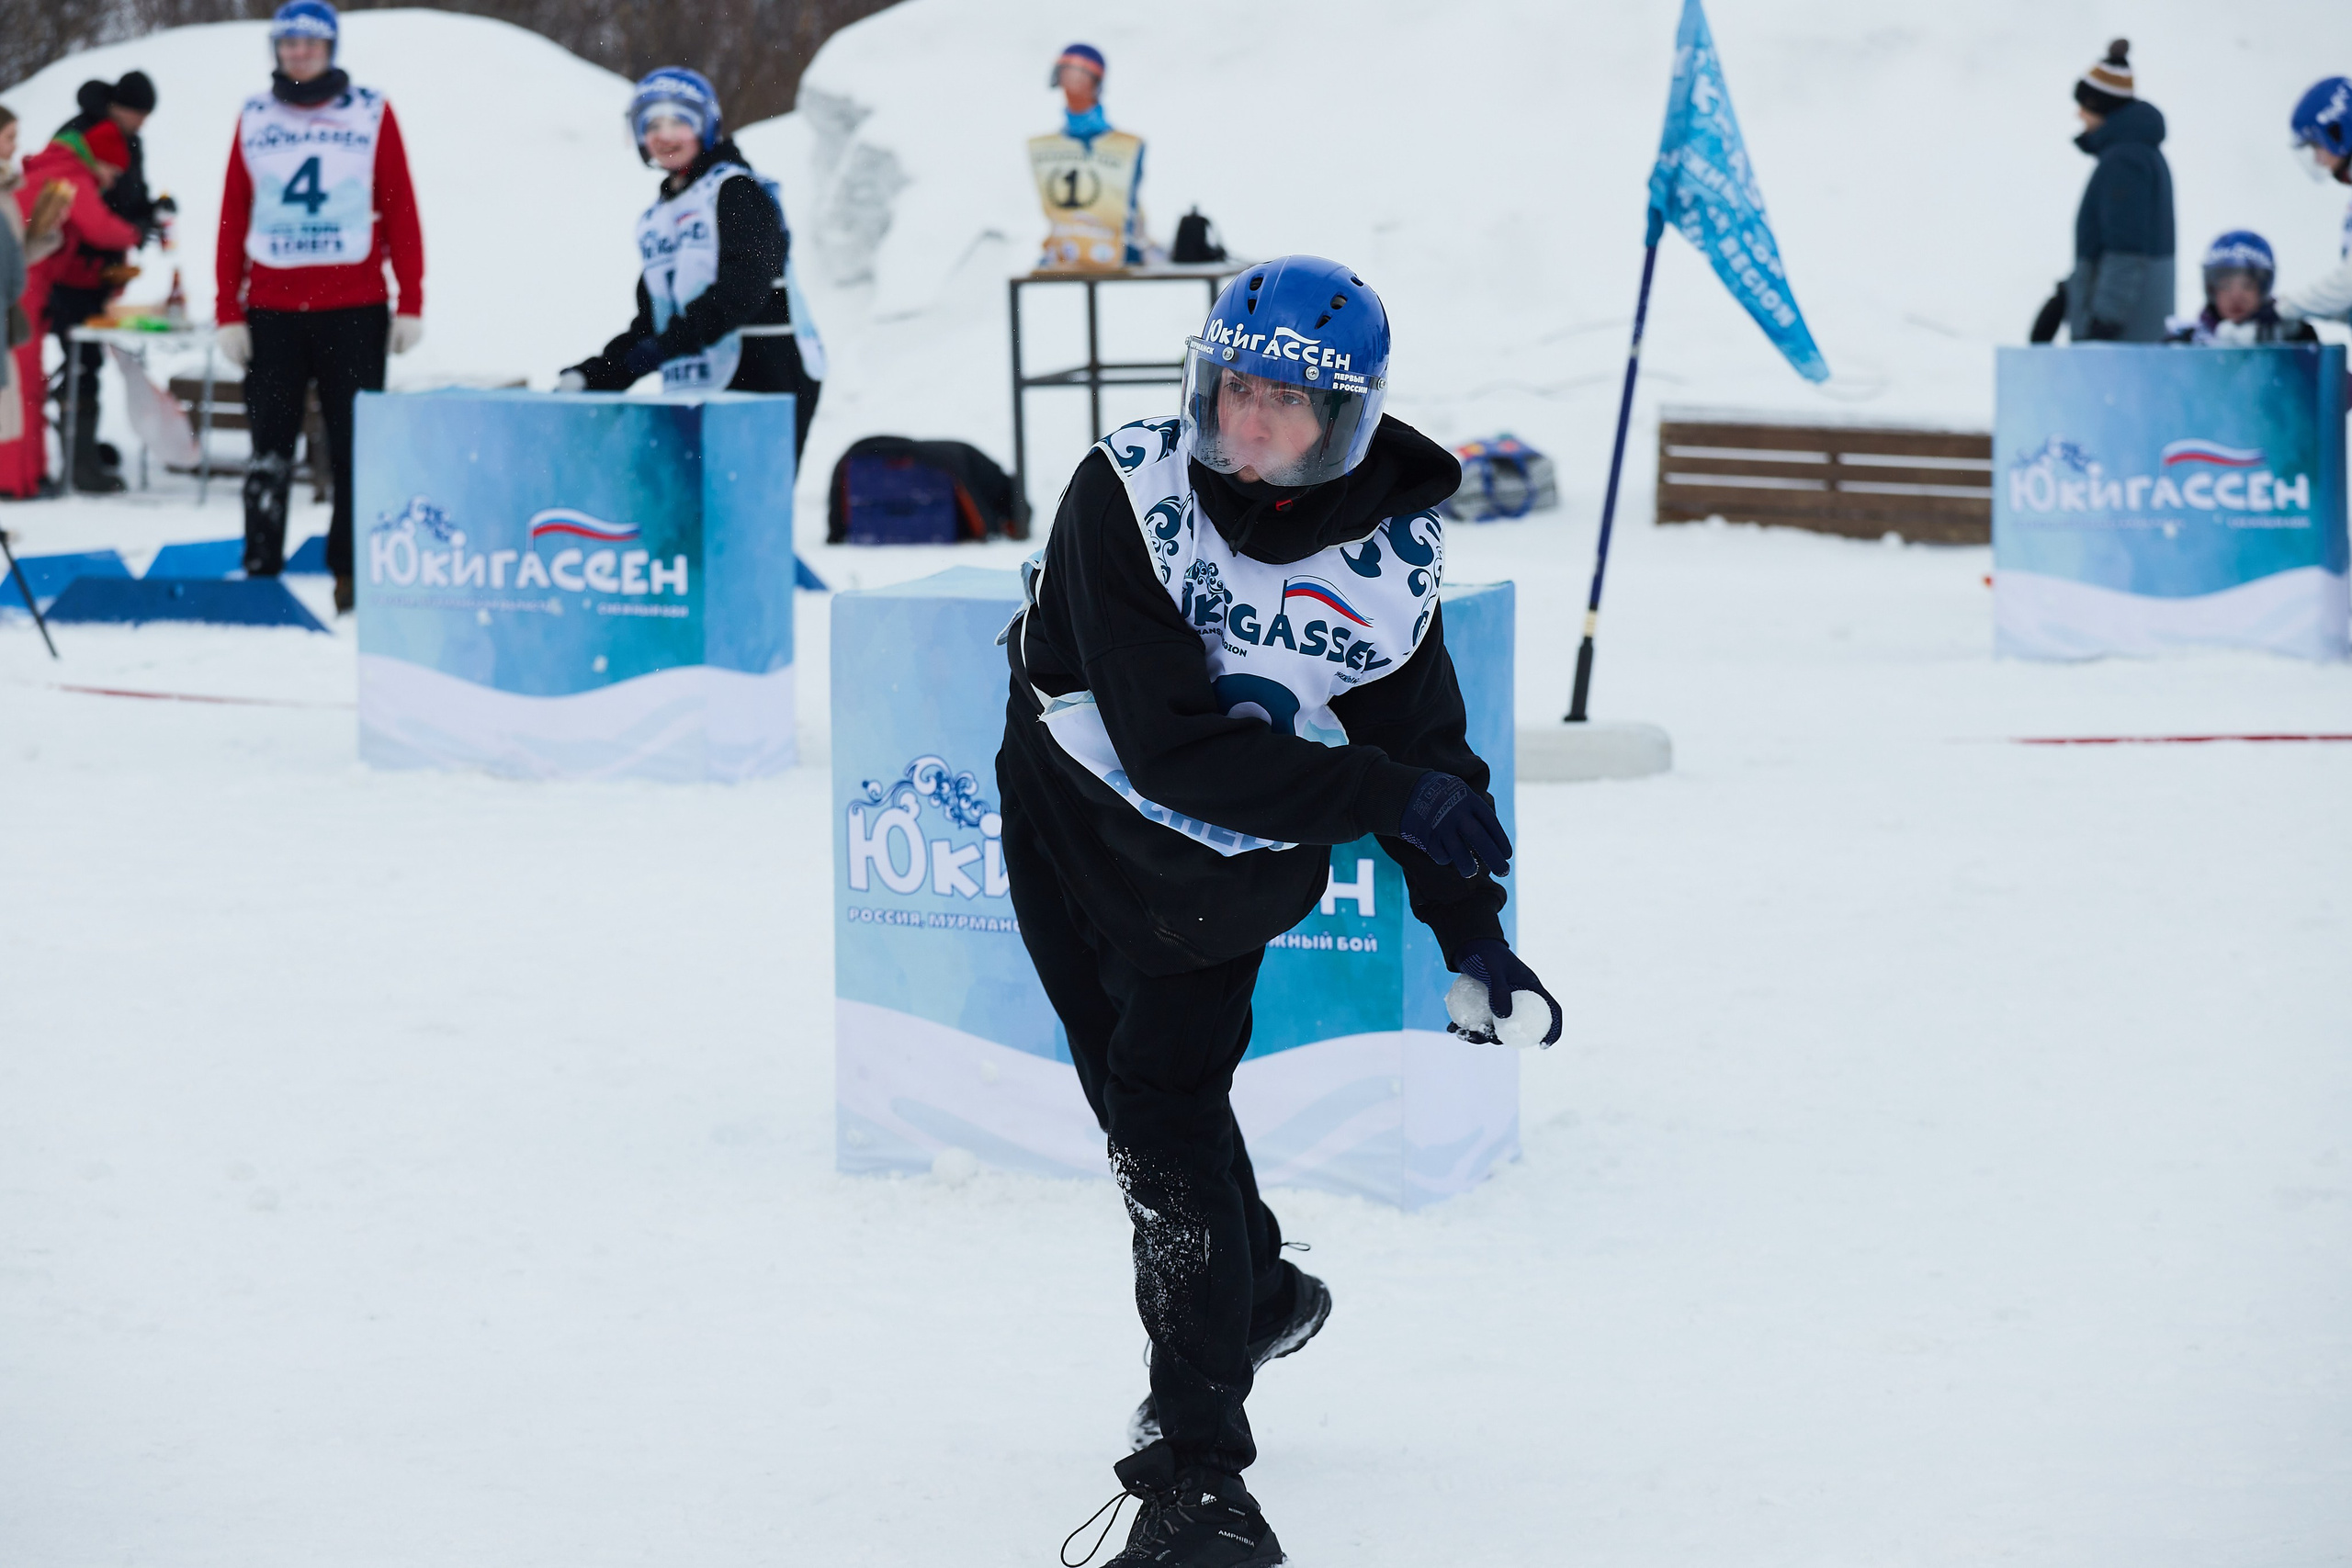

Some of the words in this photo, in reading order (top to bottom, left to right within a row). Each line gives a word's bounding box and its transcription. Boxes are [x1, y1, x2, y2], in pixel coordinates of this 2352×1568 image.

[282, 156, 328, 214] 4
[1062, 167, 1082, 209] 1
[1205, 318, 1351, 371] ЮКИГАССЕН
[1333, 372, 1365, 384] ПЕРВЫЕ
[1340, 383, 1368, 394] РОССИИ
[2009, 464, 2311, 512] ЮКИГАССЕН
[369, 529, 689, 596] ЮКИГАССЕН
[848, 907, 924, 929] РОССИЯ,
[1336, 933, 1379, 953] БОЙ
[1217, 1529, 1255, 1548] AMPHIBIA
